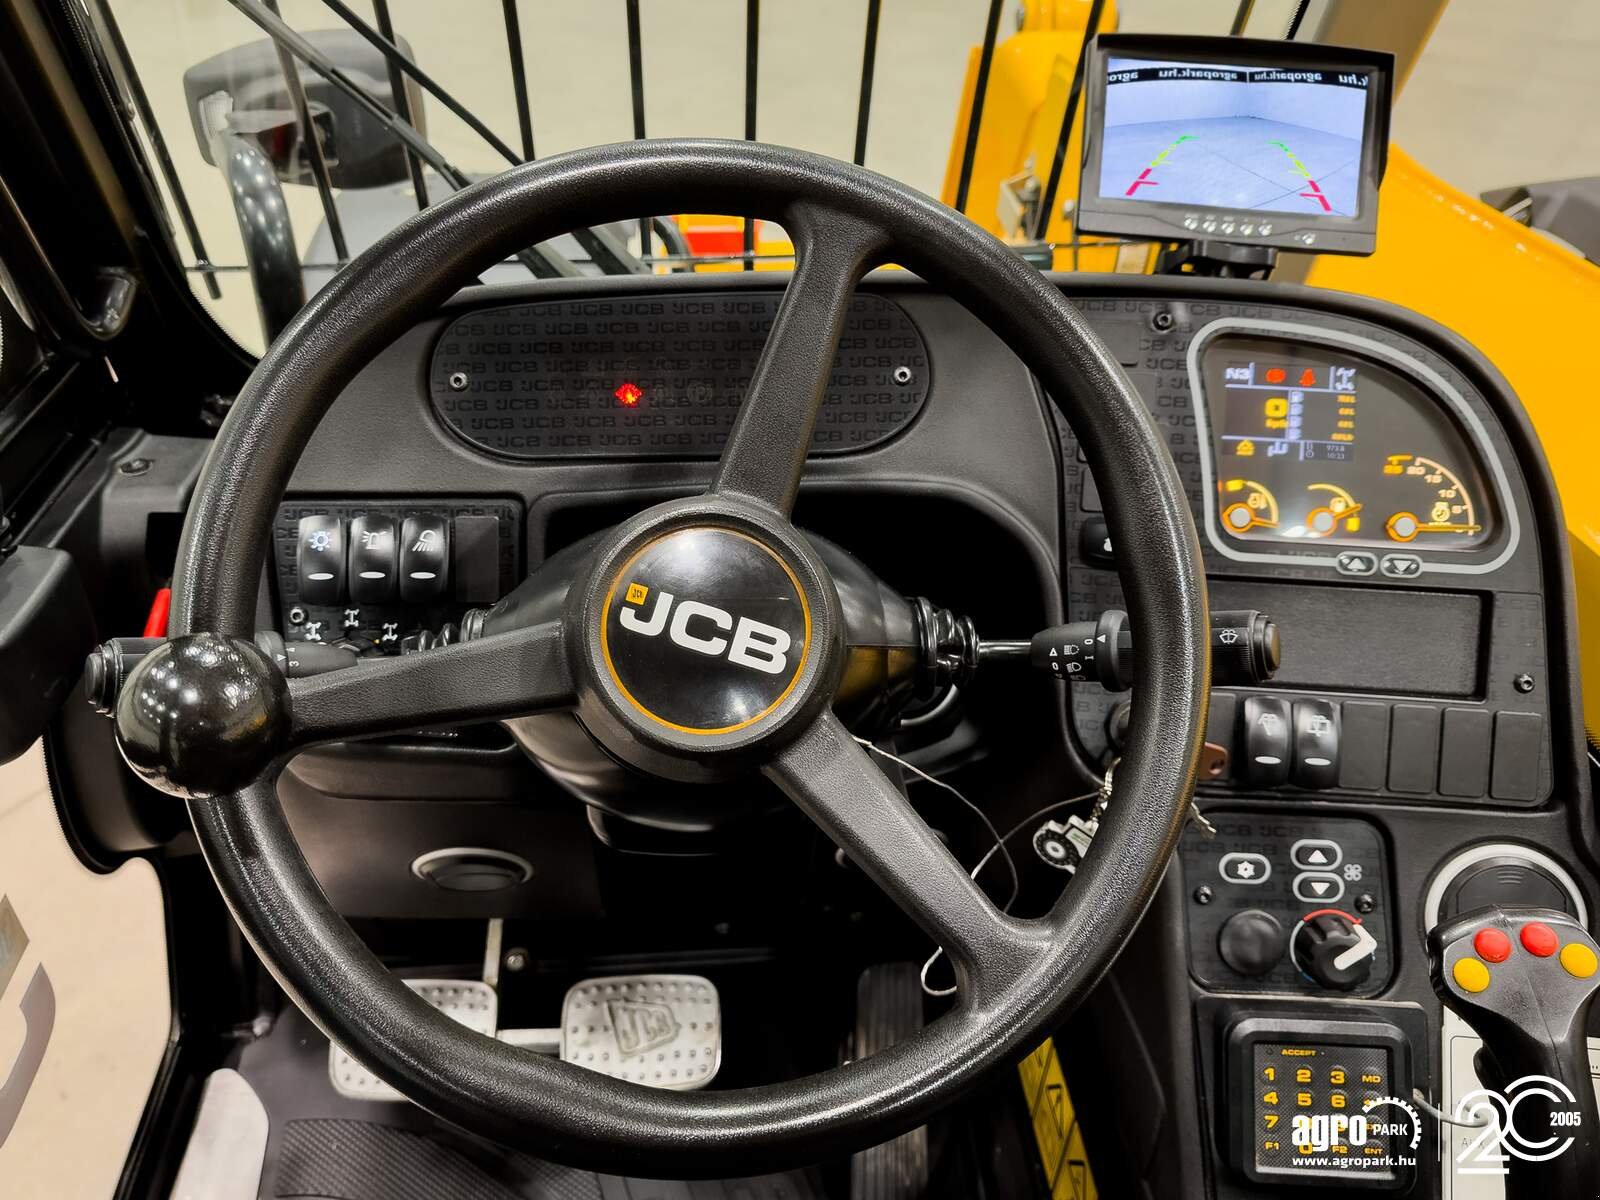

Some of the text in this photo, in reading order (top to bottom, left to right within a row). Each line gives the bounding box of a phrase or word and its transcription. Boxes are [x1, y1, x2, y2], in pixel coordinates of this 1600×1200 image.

[622, 303, 664, 314] JCB
[672, 302, 715, 314] JCB
[723, 302, 766, 313] JCB
[545, 323, 588, 335] JCB
[596, 322, 639, 334] JCB
[469, 343, 511, 354] JCB
[520, 342, 564, 354] JCB
[495, 361, 538, 372] JCB
[1406, 466, 1426, 476] 20
[1424, 474, 1442, 483] 15
[1438, 489, 1456, 498] 10
[620, 591, 792, 674] JCB
[1264, 1068, 1381, 1084] 1 2 3 MD
[1263, 1091, 1345, 1108] 4 5 6
[1264, 1115, 1279, 1129] 7
[1265, 1142, 1280, 1150] F1
[1332, 1146, 1348, 1154] F2
